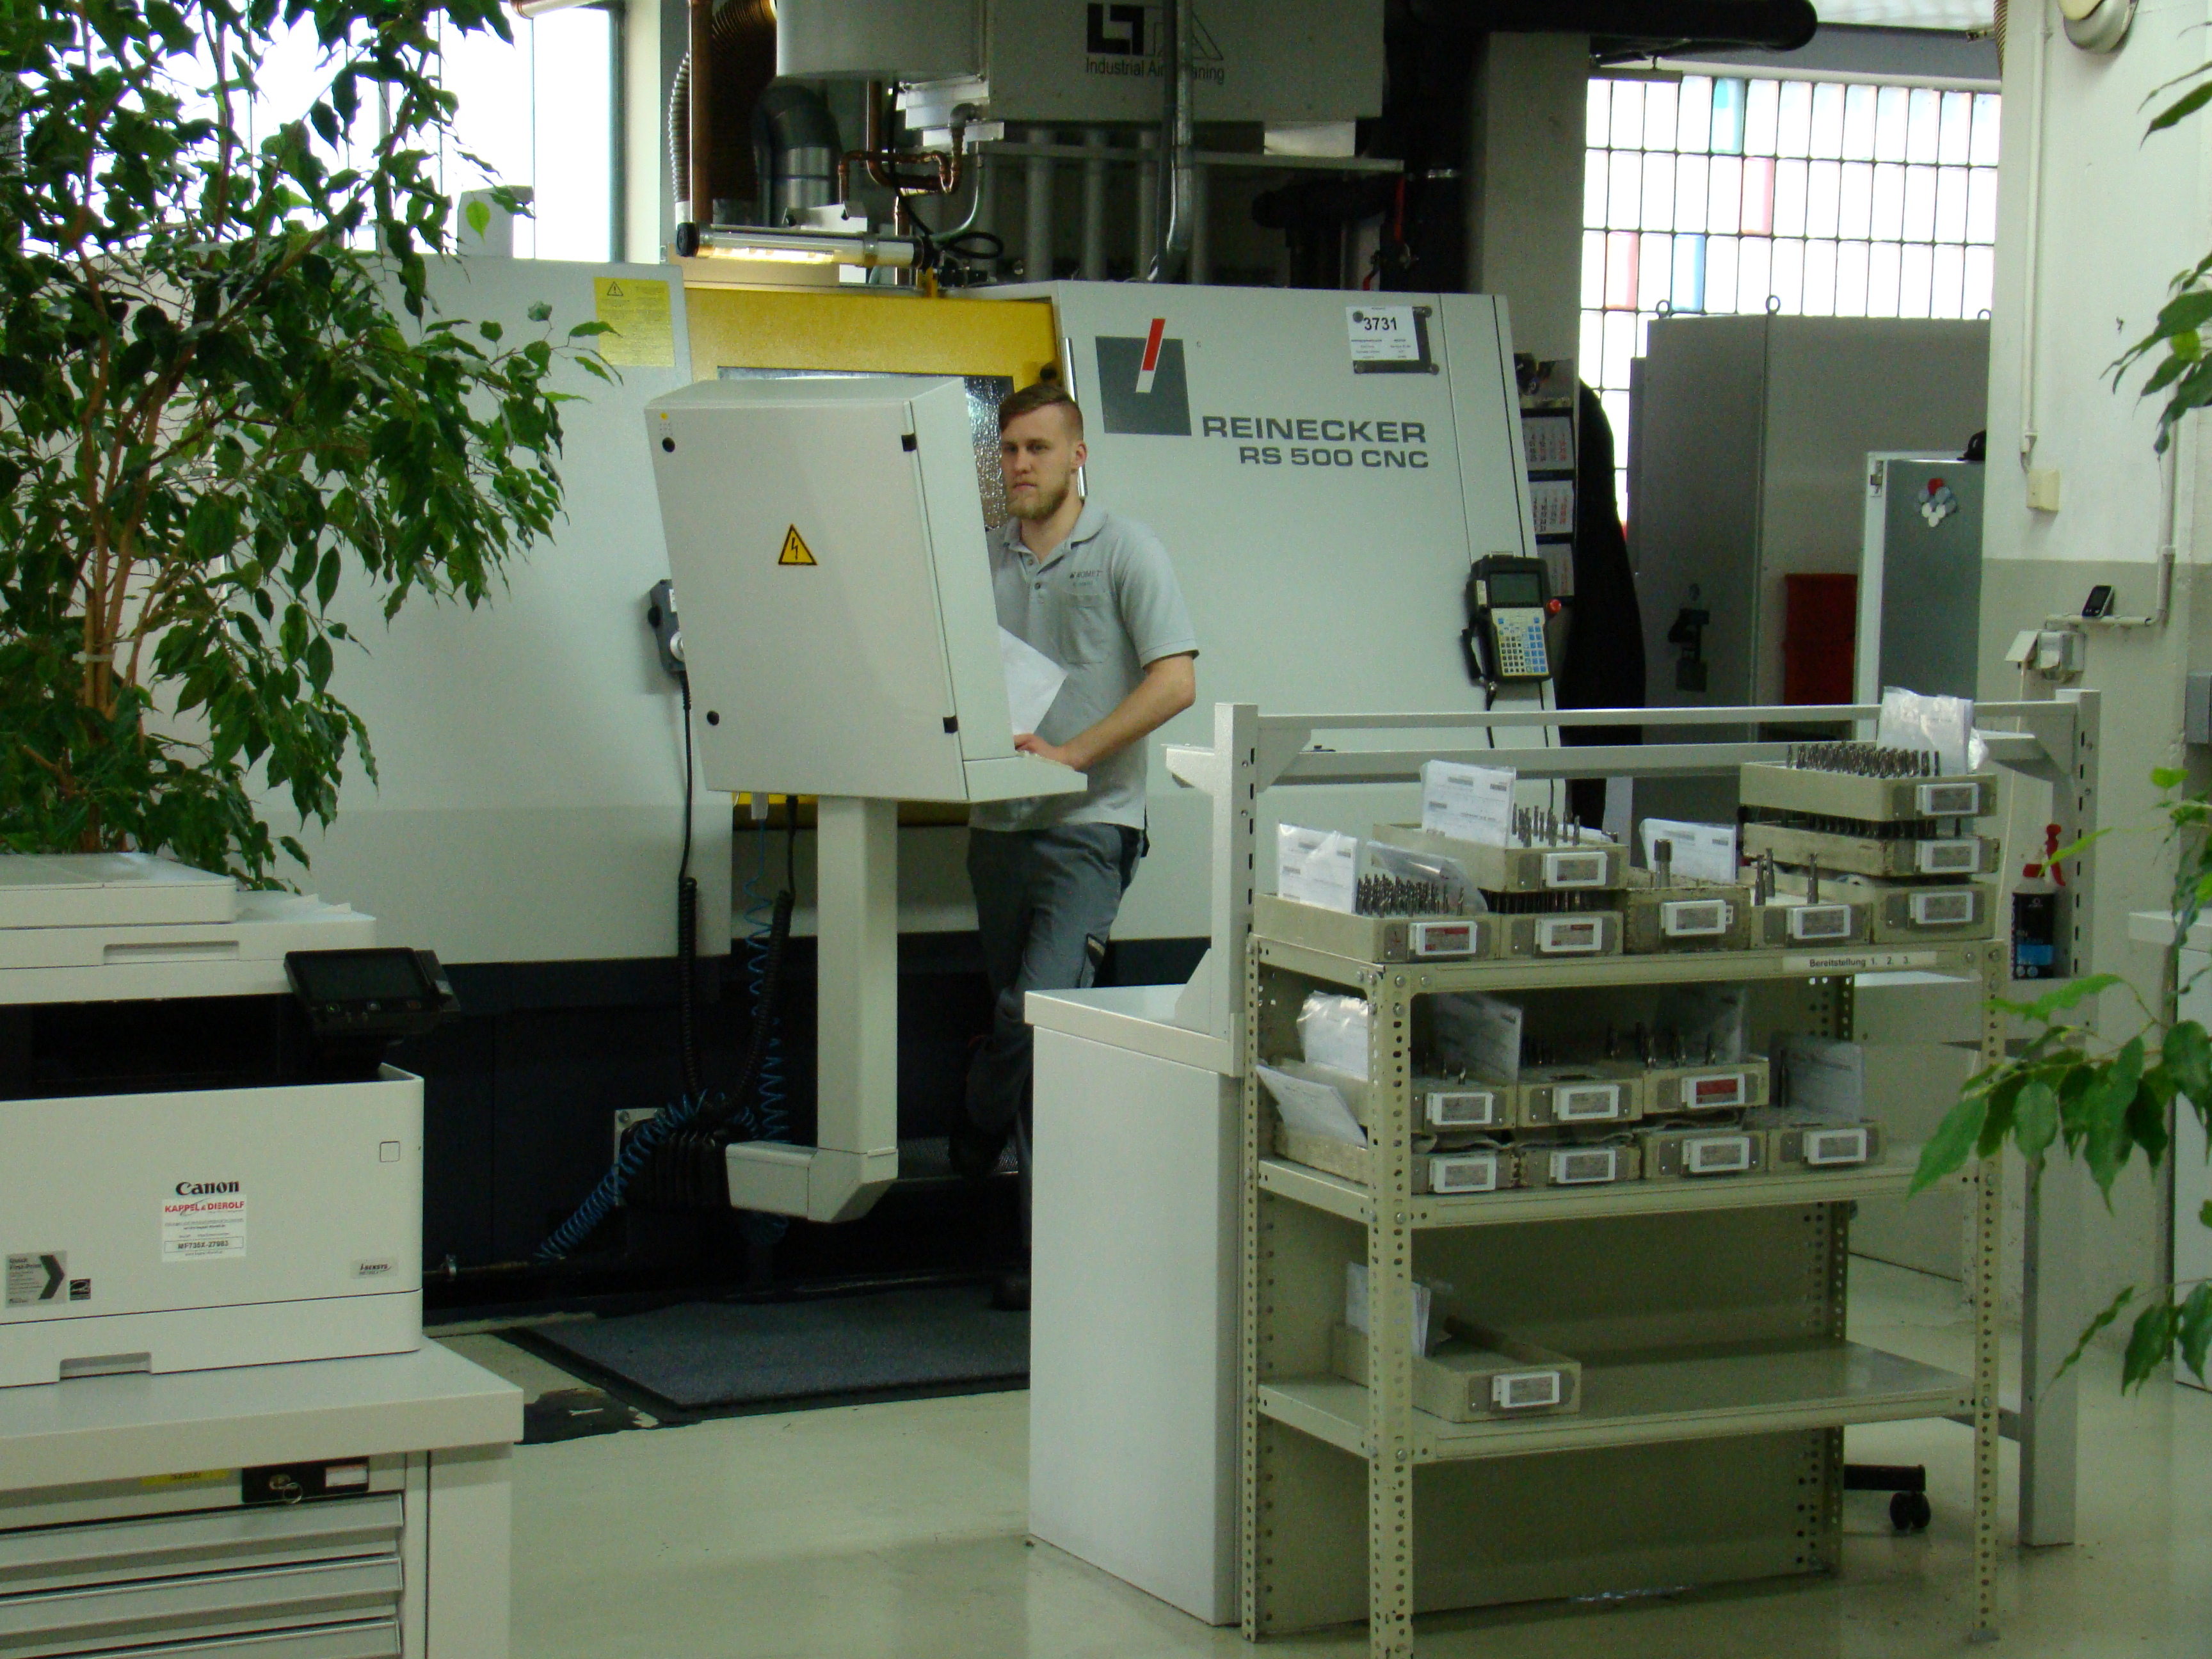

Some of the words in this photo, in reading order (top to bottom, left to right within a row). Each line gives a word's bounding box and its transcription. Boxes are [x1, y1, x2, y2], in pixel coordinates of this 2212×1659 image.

[1086, 57, 1144, 77] Industrial
[1147, 60, 1164, 77] Air
[1363, 317, 1397, 330] 3731
[1203, 416, 1426, 443] REINECKER
[1239, 446, 1282, 465] RS
[1291, 448, 1353, 467] 500
[1361, 449, 1429, 468] CNC
[1809, 958, 1866, 968] Bereitstellung
[175, 1181, 240, 1196] Canon
[164, 1203, 201, 1213] KAPPEL
[207, 1201, 244, 1210] DIEROLF
